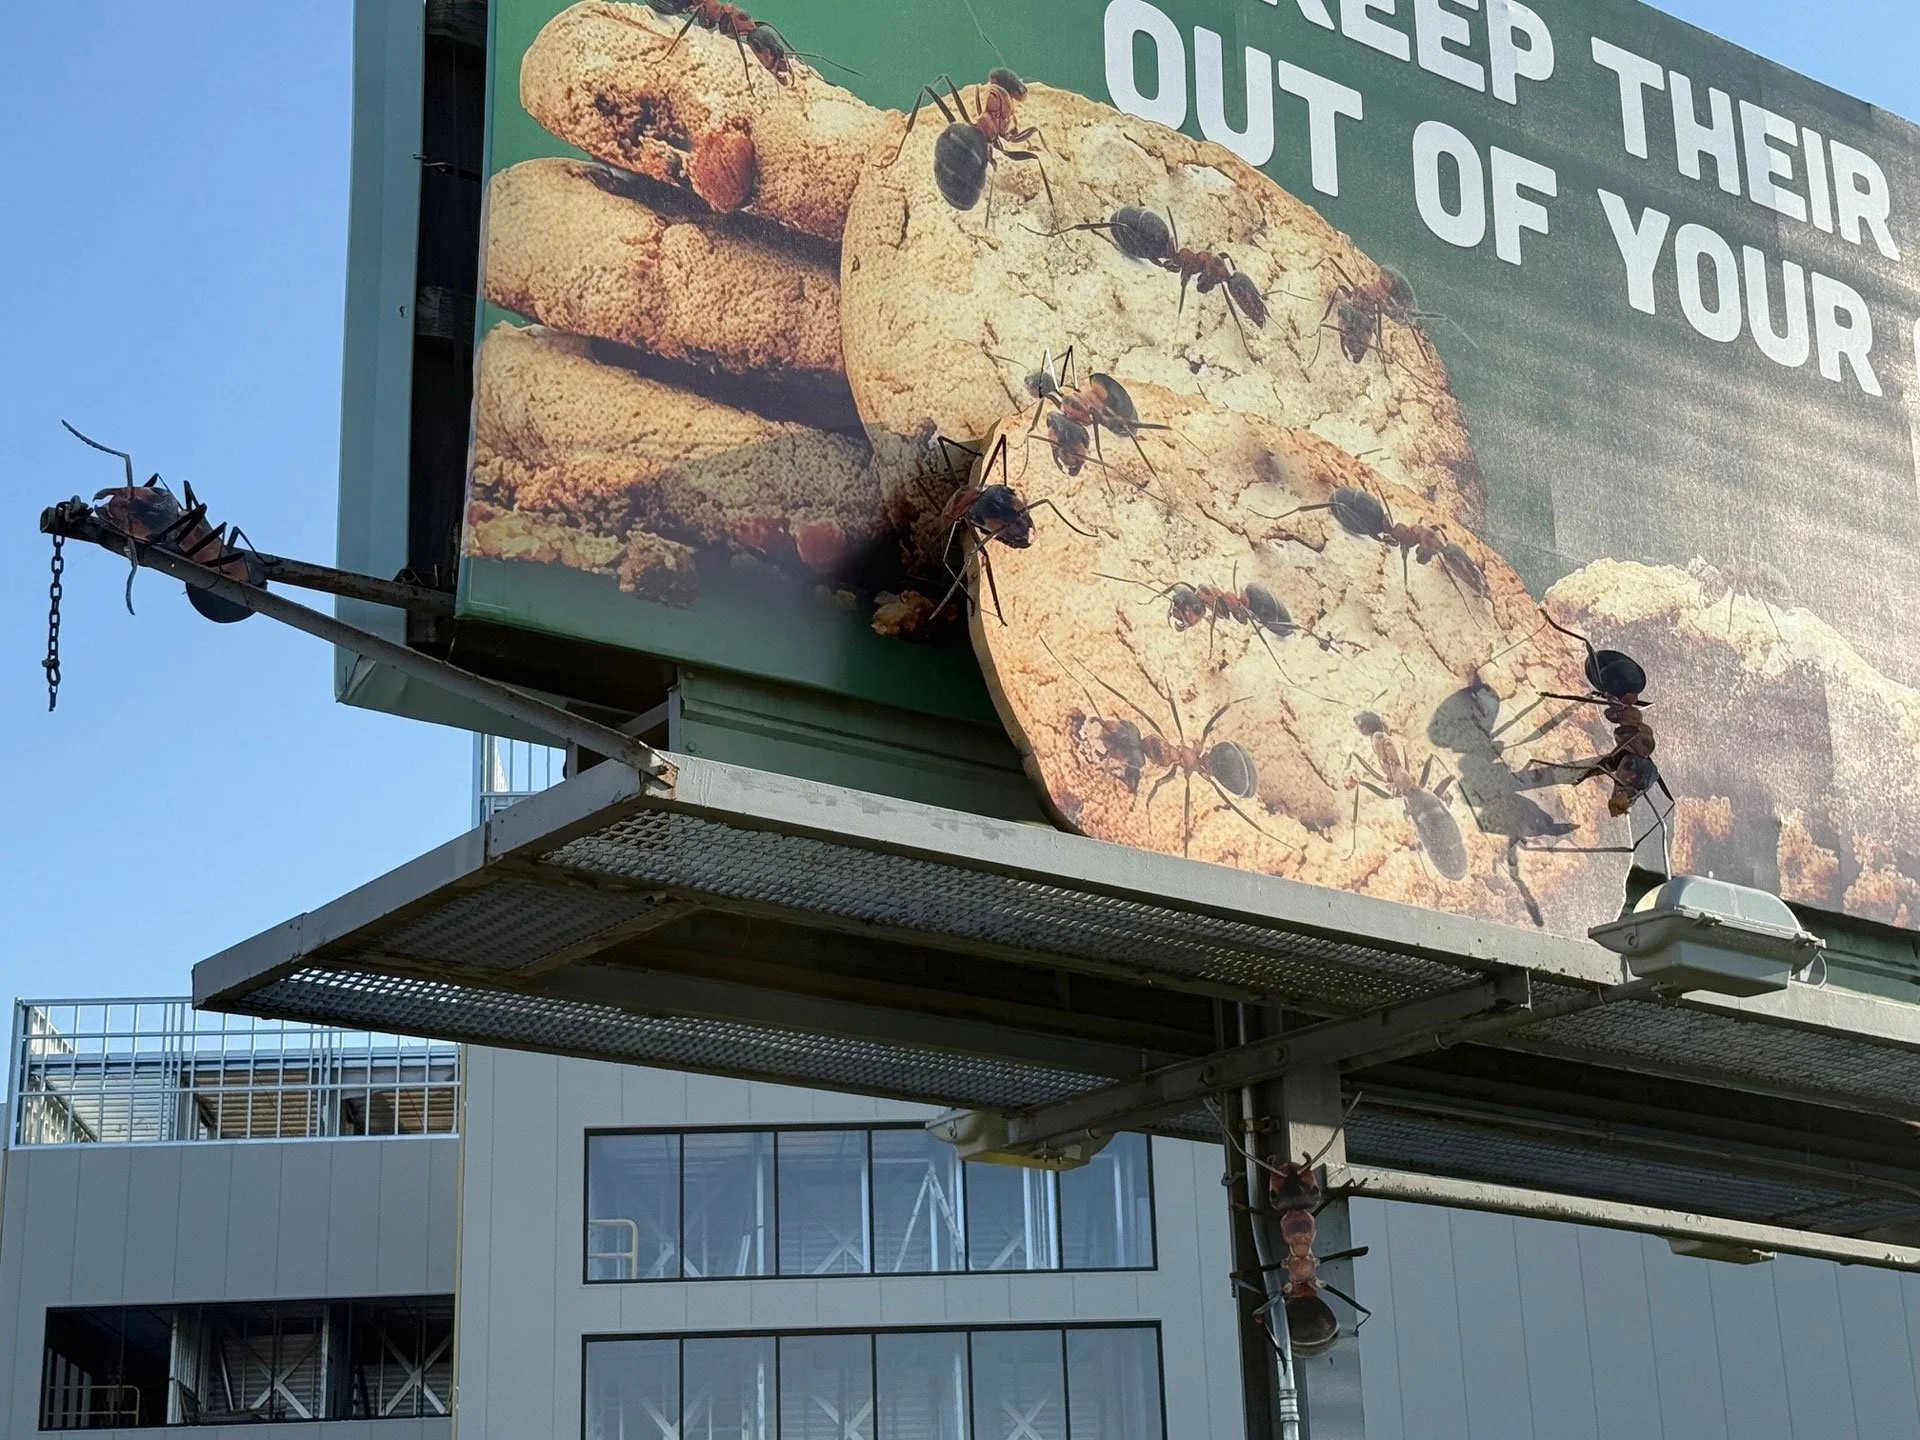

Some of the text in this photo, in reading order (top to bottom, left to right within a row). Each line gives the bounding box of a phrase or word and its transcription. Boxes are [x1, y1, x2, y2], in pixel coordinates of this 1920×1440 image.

[1103, 0, 1363, 198] OUT
[1412, 120, 1557, 266] OF
[1597, 188, 1884, 397] YOUR
[1261, 0, 1901, 262] EP THEIR
